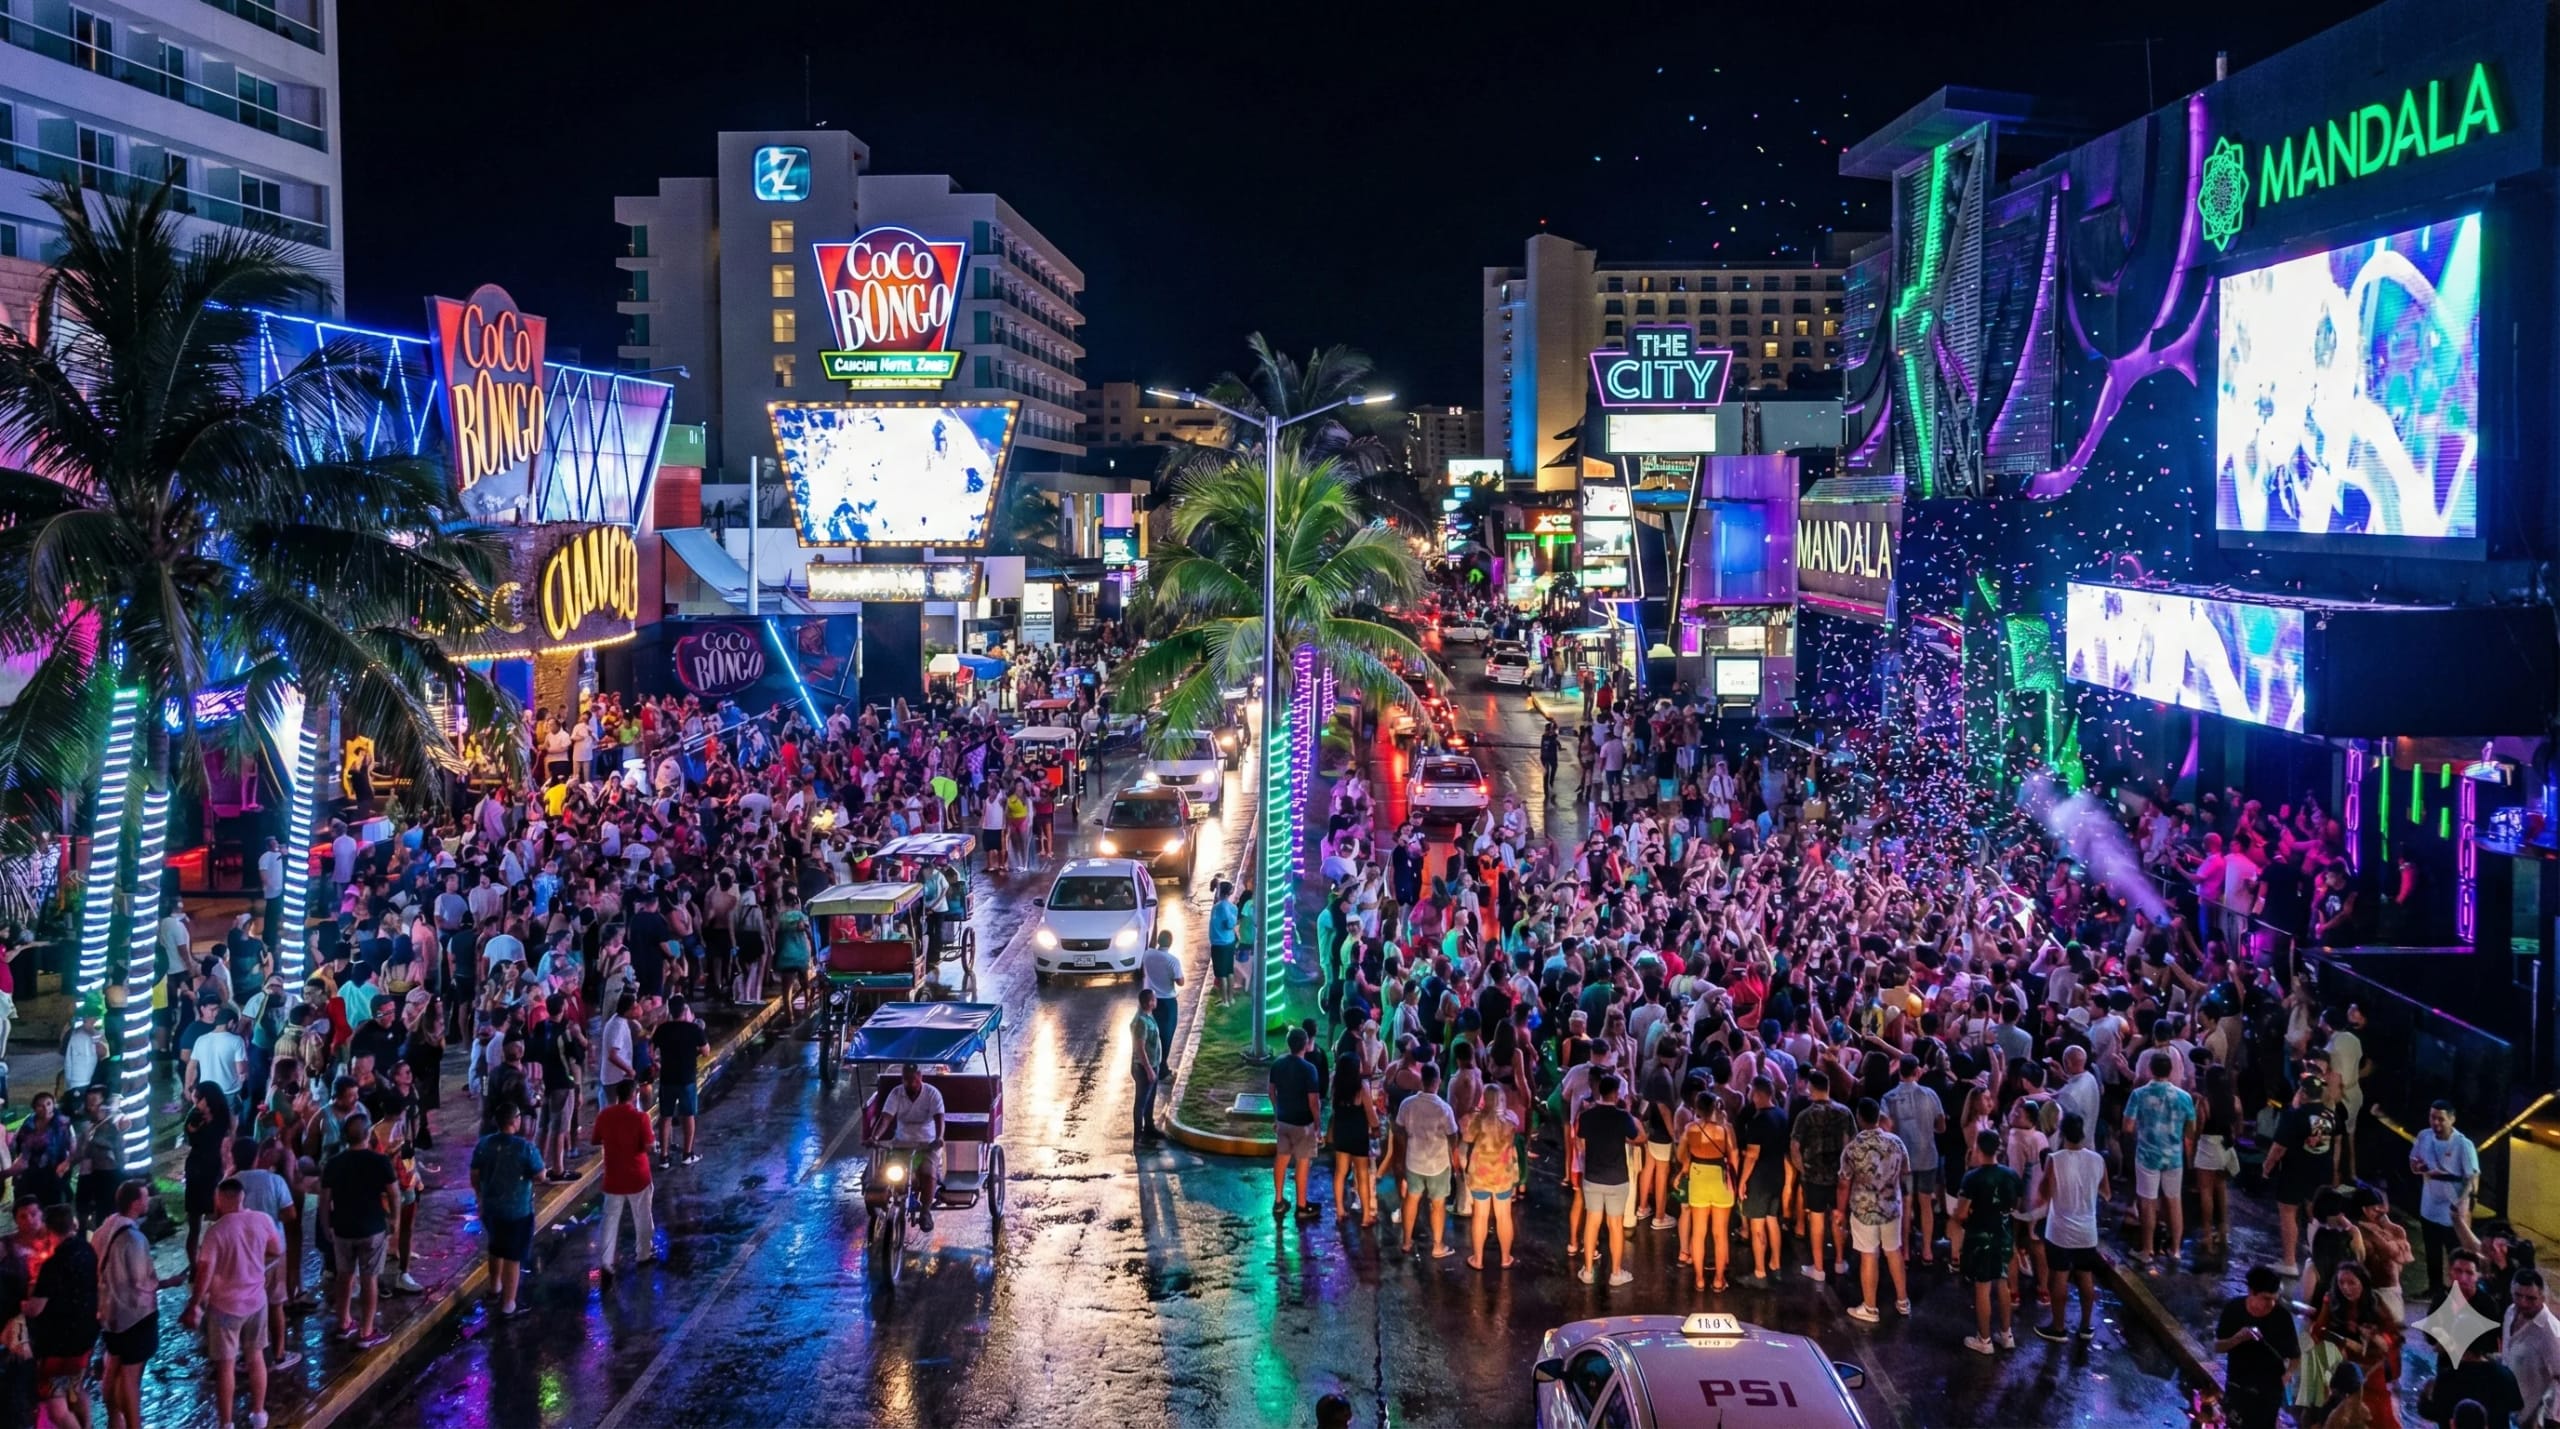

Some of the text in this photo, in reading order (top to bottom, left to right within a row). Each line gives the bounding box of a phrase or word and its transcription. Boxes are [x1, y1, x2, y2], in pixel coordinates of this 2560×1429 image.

[2258, 61, 2500, 208] MANDALA
[832, 279, 952, 352] BONGO
[1636, 333, 1688, 357] THE
[1606, 359, 1719, 400] CITY
[451, 368, 545, 494] BONGO
[1796, 519, 1893, 581] MANDALA
[693, 648, 765, 692] BONGO
[1698, 1379, 1799, 1408] PSI
